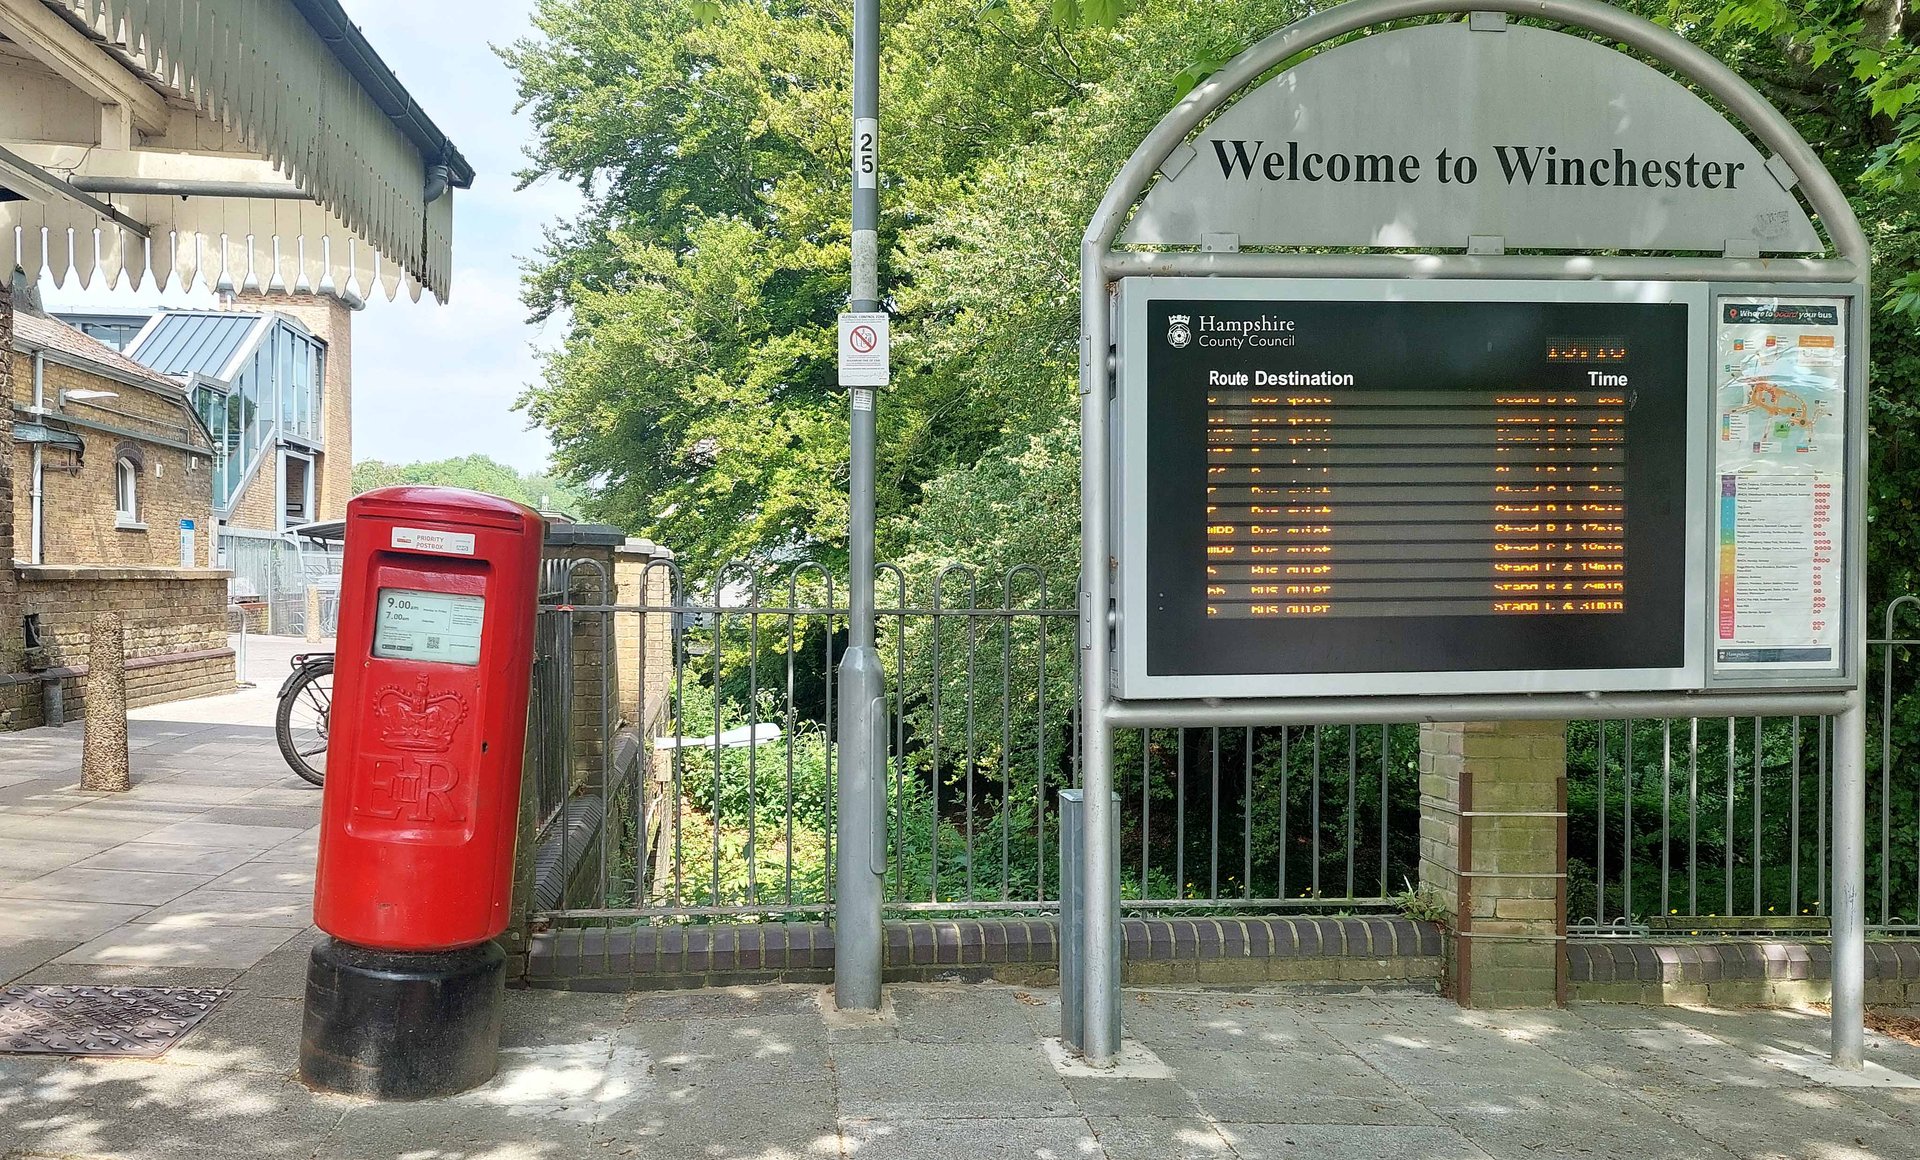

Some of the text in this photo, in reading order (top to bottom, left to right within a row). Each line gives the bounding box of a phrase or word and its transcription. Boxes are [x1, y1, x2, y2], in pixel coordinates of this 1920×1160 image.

[1210, 139, 1745, 189] Welcome to Winchester
[1199, 315, 1295, 336] Hampshire
[1199, 334, 1295, 350] County Council
[1209, 370, 1628, 386] Route Destination Time
[416, 535, 444, 543] PRIORITY
[416, 542, 443, 550] POSTBOX
